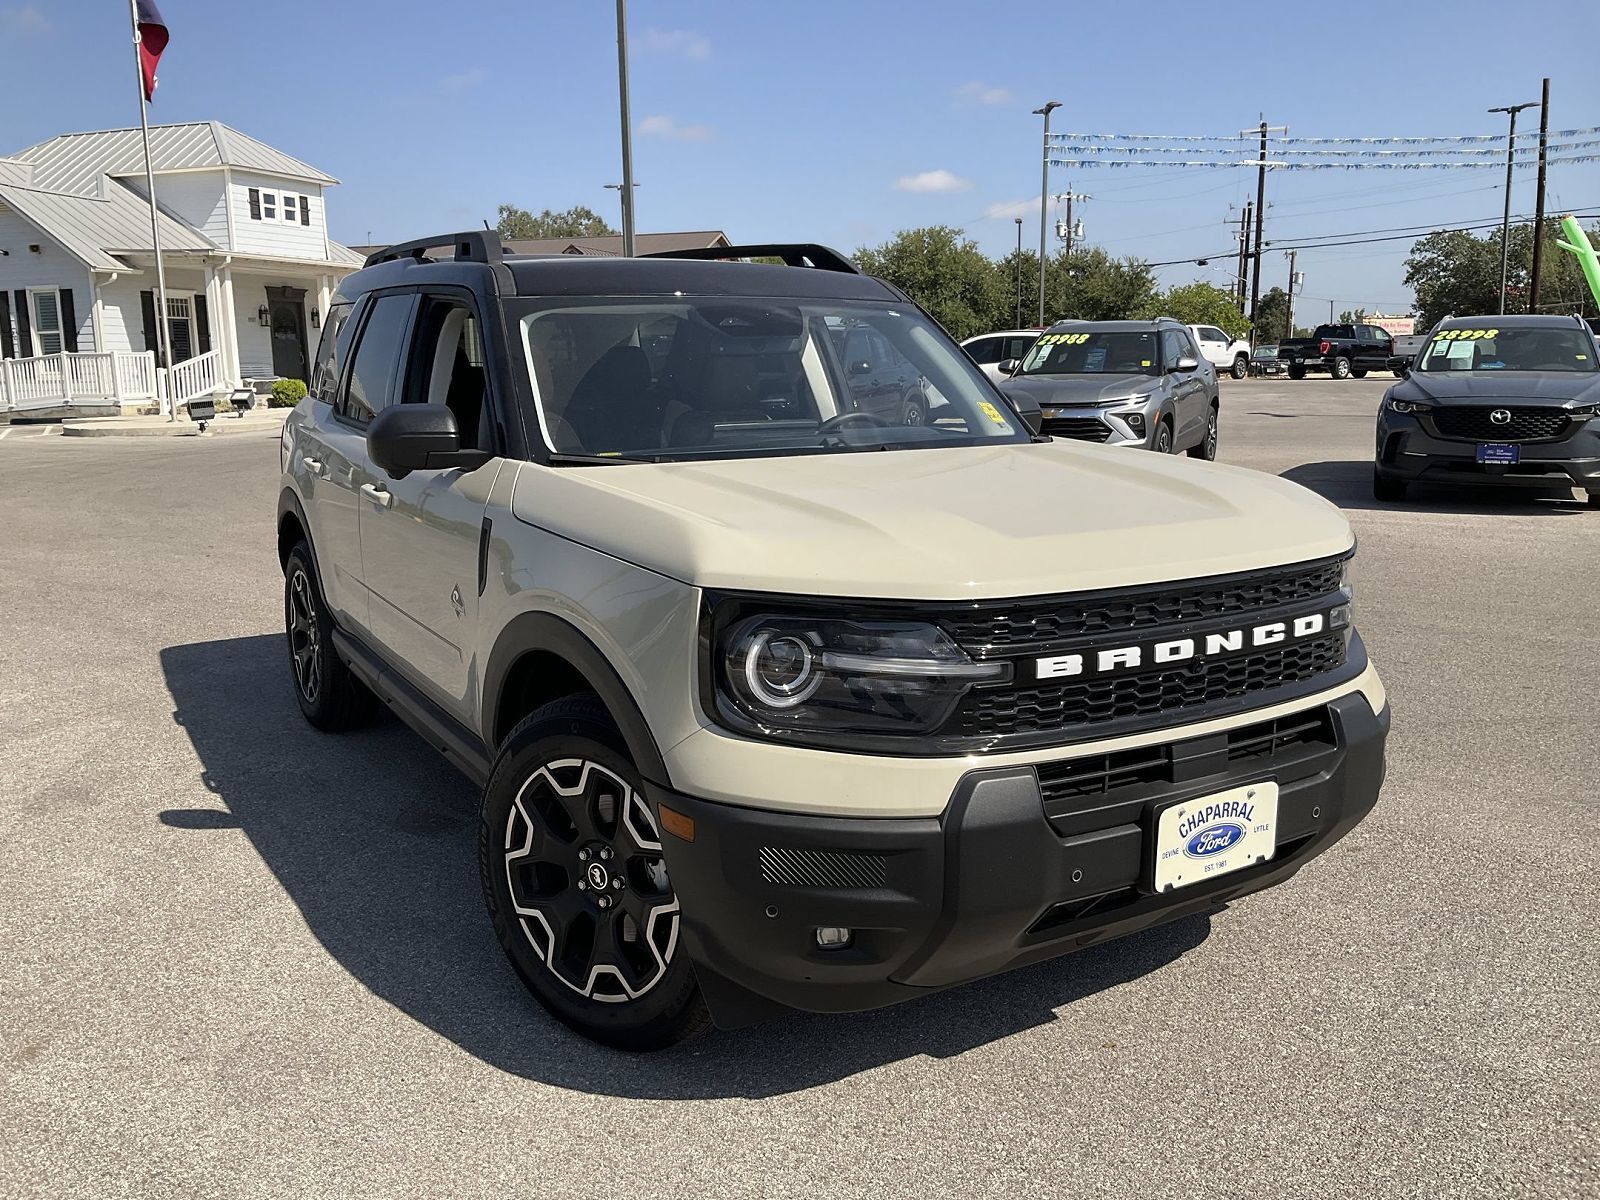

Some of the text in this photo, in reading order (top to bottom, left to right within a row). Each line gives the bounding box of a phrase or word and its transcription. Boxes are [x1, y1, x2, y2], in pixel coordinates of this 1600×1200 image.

[1037, 333, 1091, 346] 29988
[1432, 329, 1500, 341] 28998
[1036, 613, 1323, 680] BRONCO
[1179, 801, 1254, 838] CHAPARRAL
[1254, 824, 1269, 833] LYTLE
[1197, 829, 1231, 853] Ford
[1162, 848, 1179, 859] DEVINE
[1204, 864, 1214, 872] EST.
